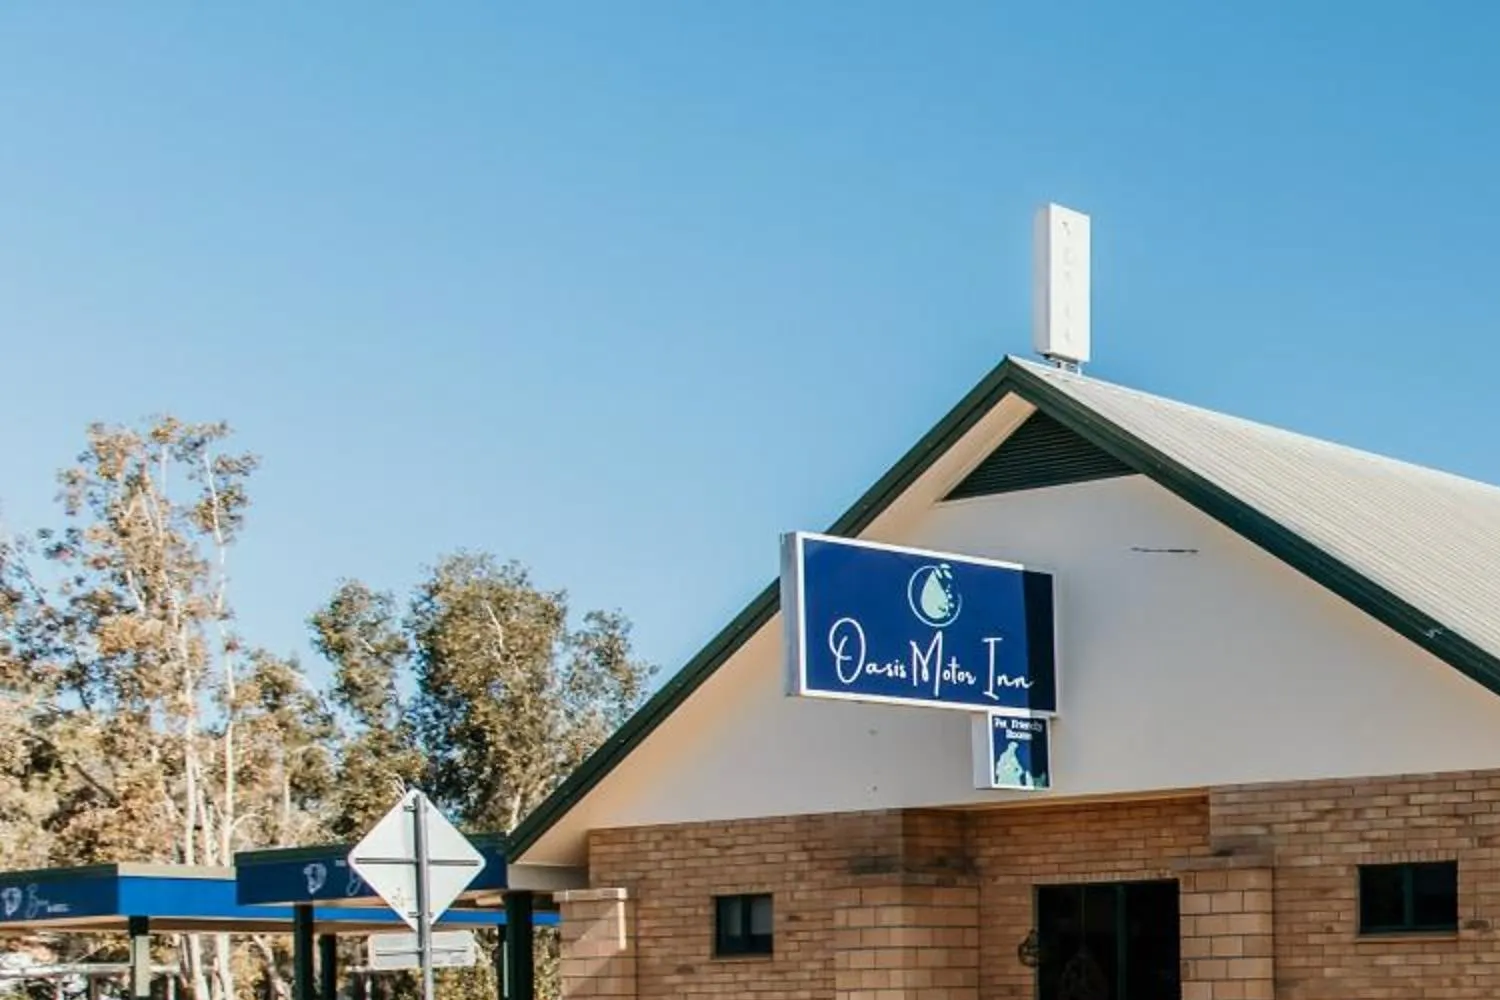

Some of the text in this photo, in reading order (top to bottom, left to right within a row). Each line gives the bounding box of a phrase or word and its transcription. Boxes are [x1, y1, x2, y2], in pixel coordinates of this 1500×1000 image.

[828, 617, 1034, 701] Oasis Motor Inn
